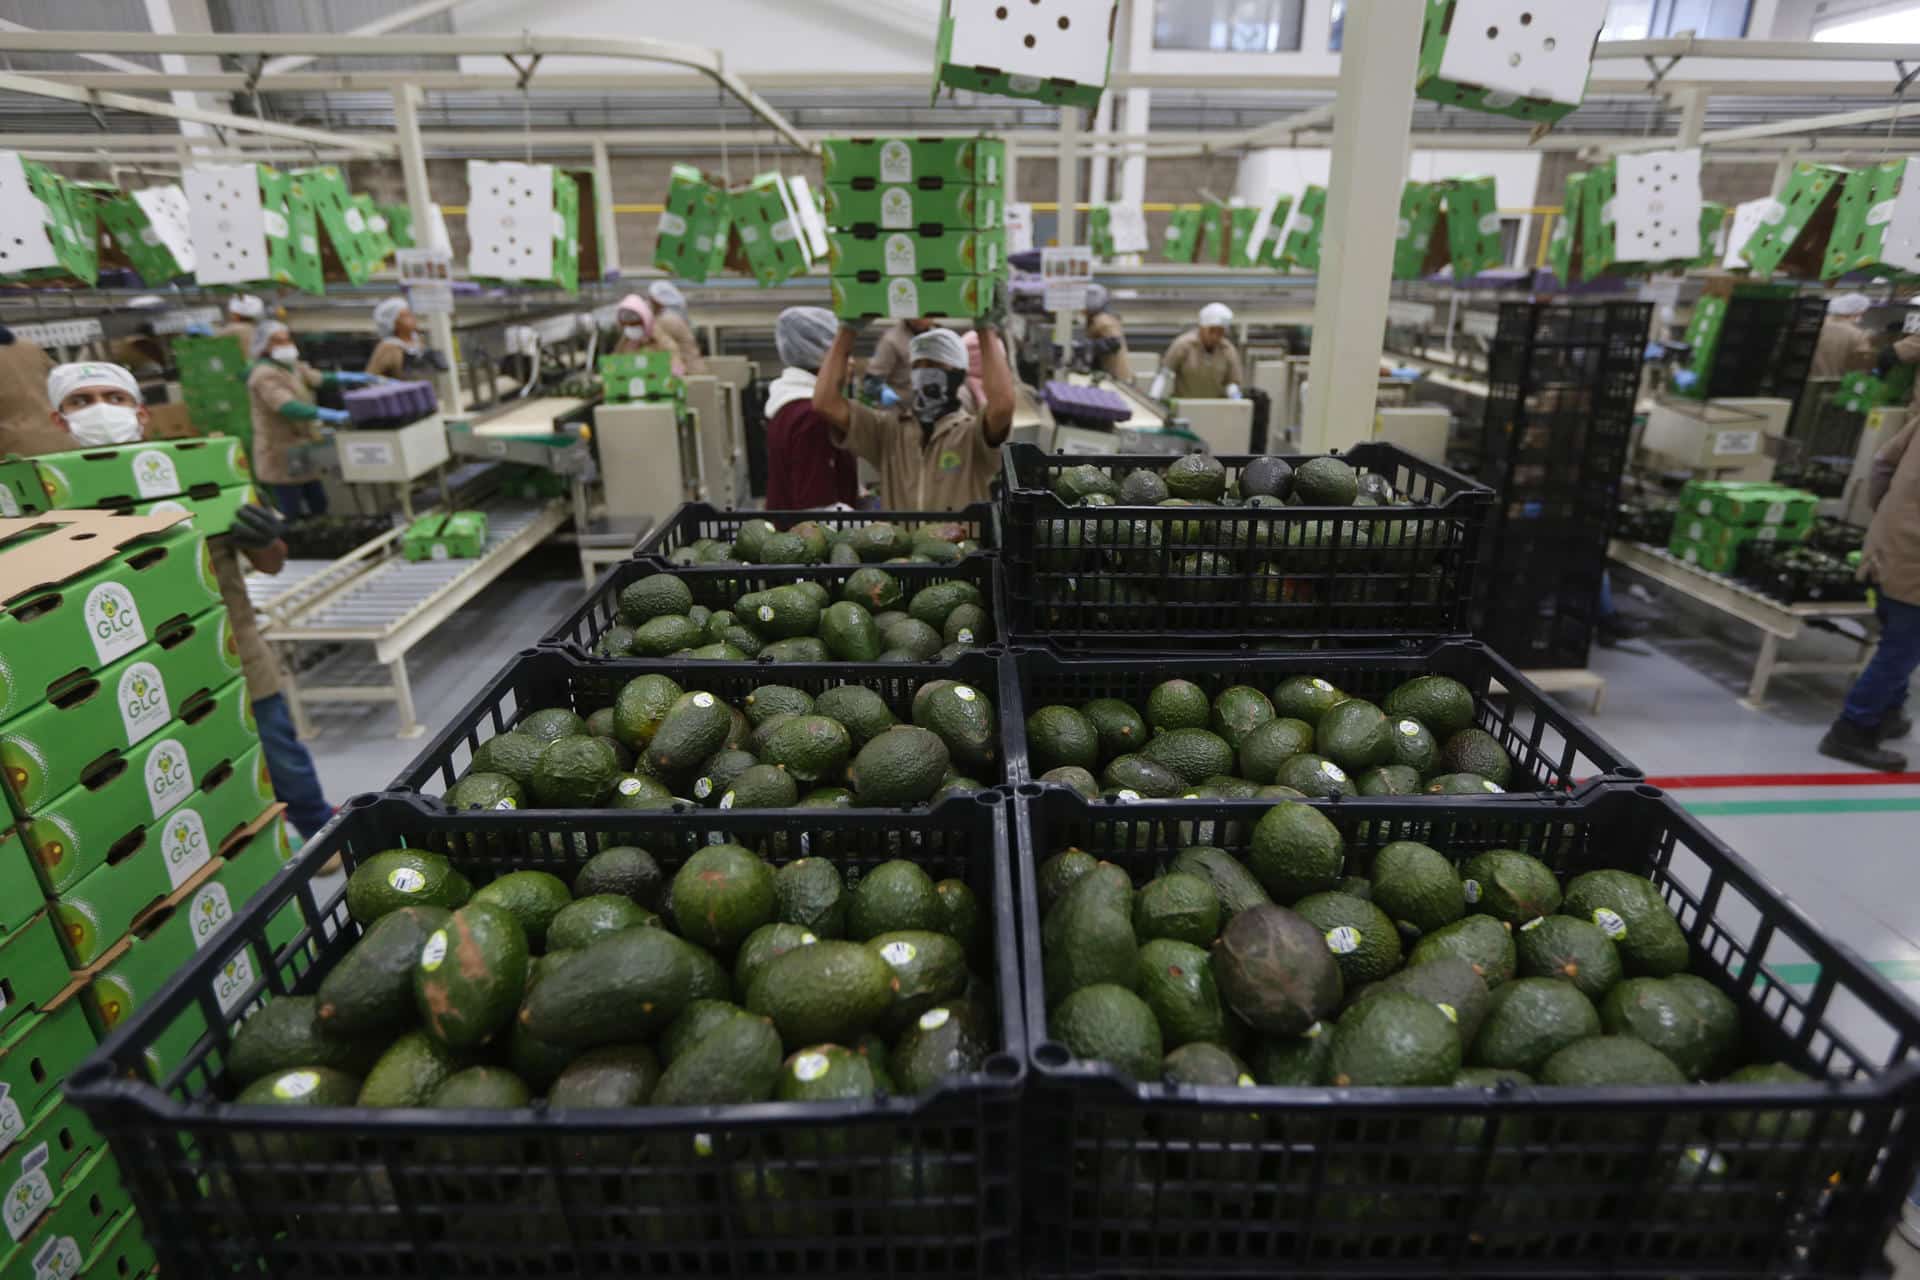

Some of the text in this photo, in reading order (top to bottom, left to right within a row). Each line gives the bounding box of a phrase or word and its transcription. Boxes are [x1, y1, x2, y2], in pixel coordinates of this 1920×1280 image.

[97, 609, 134, 639] GLC
[128, 688, 161, 719] GLC
[153, 763, 185, 794] GLC
[170, 832, 201, 864] GLC
[198, 903, 225, 936] GLC
[221, 964, 246, 998] GLC
